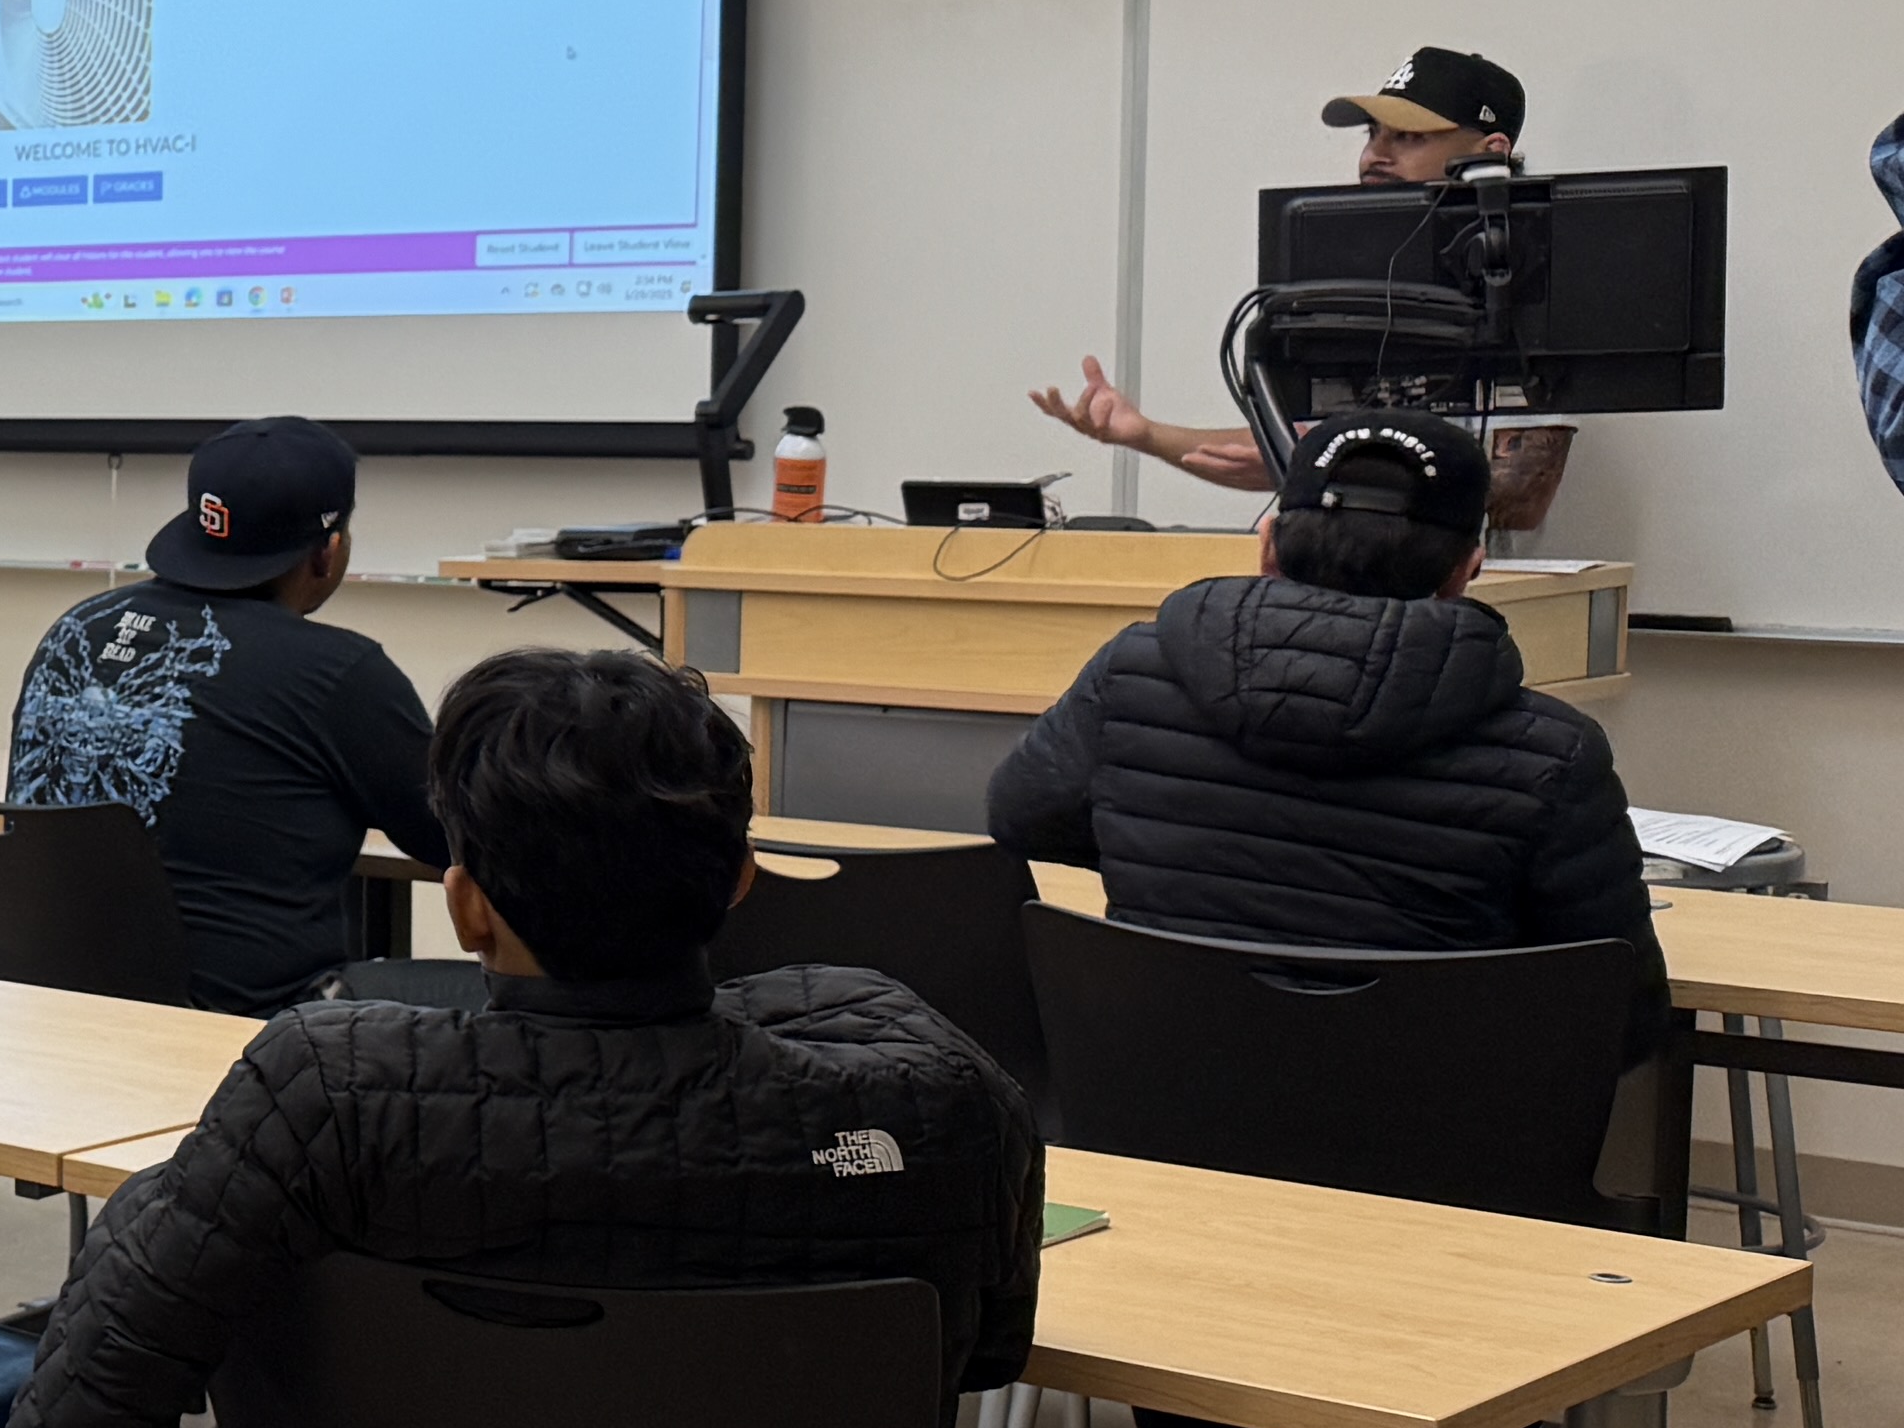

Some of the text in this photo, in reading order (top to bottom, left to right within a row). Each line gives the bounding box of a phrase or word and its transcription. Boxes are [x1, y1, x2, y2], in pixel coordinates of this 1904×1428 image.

[15, 138, 101, 162] WELCOME
[106, 138, 130, 156] TO
[199, 493, 230, 538] SD
[835, 1130, 870, 1146] THE
[812, 1145, 872, 1165] NORTH
[832, 1159, 876, 1177] FACE
